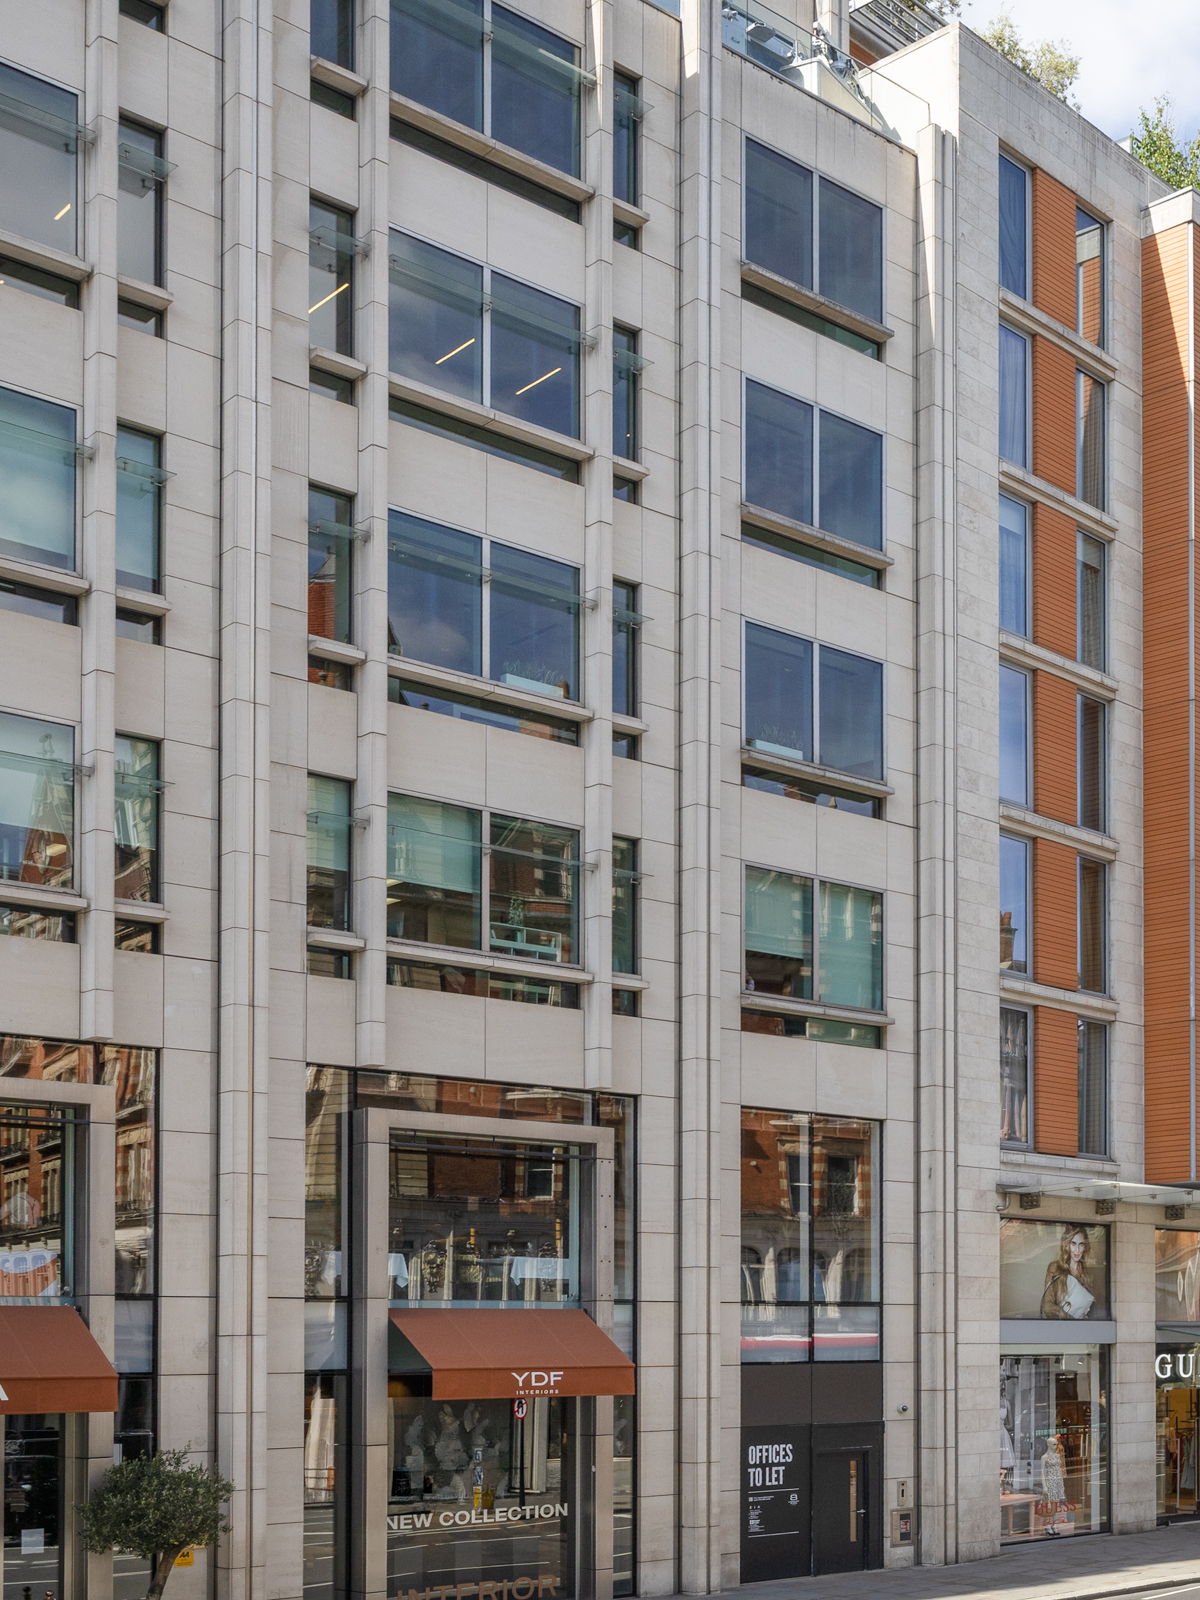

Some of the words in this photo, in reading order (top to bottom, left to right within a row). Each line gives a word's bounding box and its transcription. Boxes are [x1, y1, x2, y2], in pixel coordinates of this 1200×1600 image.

[510, 1371, 564, 1387] YDF
[748, 1443, 793, 1465] OFFICES
[747, 1467, 763, 1487] TO
[765, 1466, 786, 1486] LET
[386, 1512, 434, 1530] NEW
[438, 1503, 569, 1527] COLLECTION
[1034, 1500, 1077, 1516] GUESS
